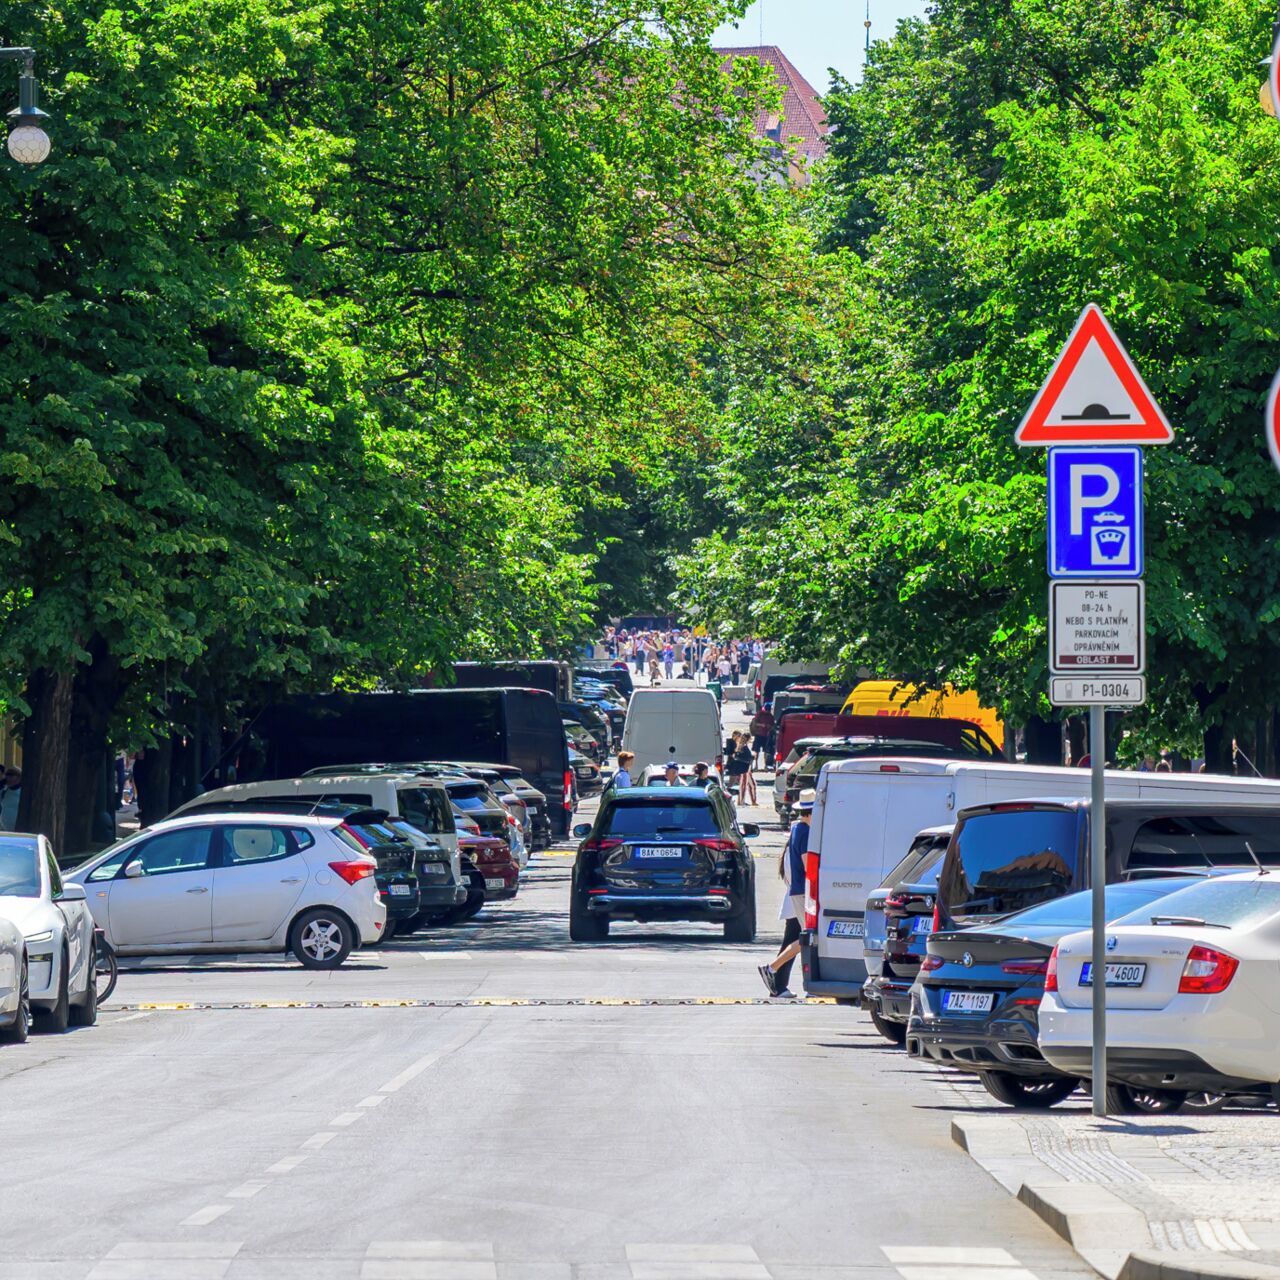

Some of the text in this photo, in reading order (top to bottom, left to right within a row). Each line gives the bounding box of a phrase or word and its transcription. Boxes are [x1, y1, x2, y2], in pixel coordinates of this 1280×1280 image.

[1070, 464, 1121, 536] P
[1085, 590, 1109, 600] PO-NE
[1081, 604, 1113, 613] 08-24 h
[1065, 615, 1128, 626] NEBO S PLATNÝM
[1075, 628, 1119, 638] PARKOVACÍM
[1074, 641, 1120, 652] OPRÁVNĚNÍM
[1076, 657, 1118, 665] OBLAST 1
[1082, 684, 1130, 697] P1-0304
[1115, 967, 1140, 980] 4600
[949, 994, 989, 1009] 7AZ 1197
